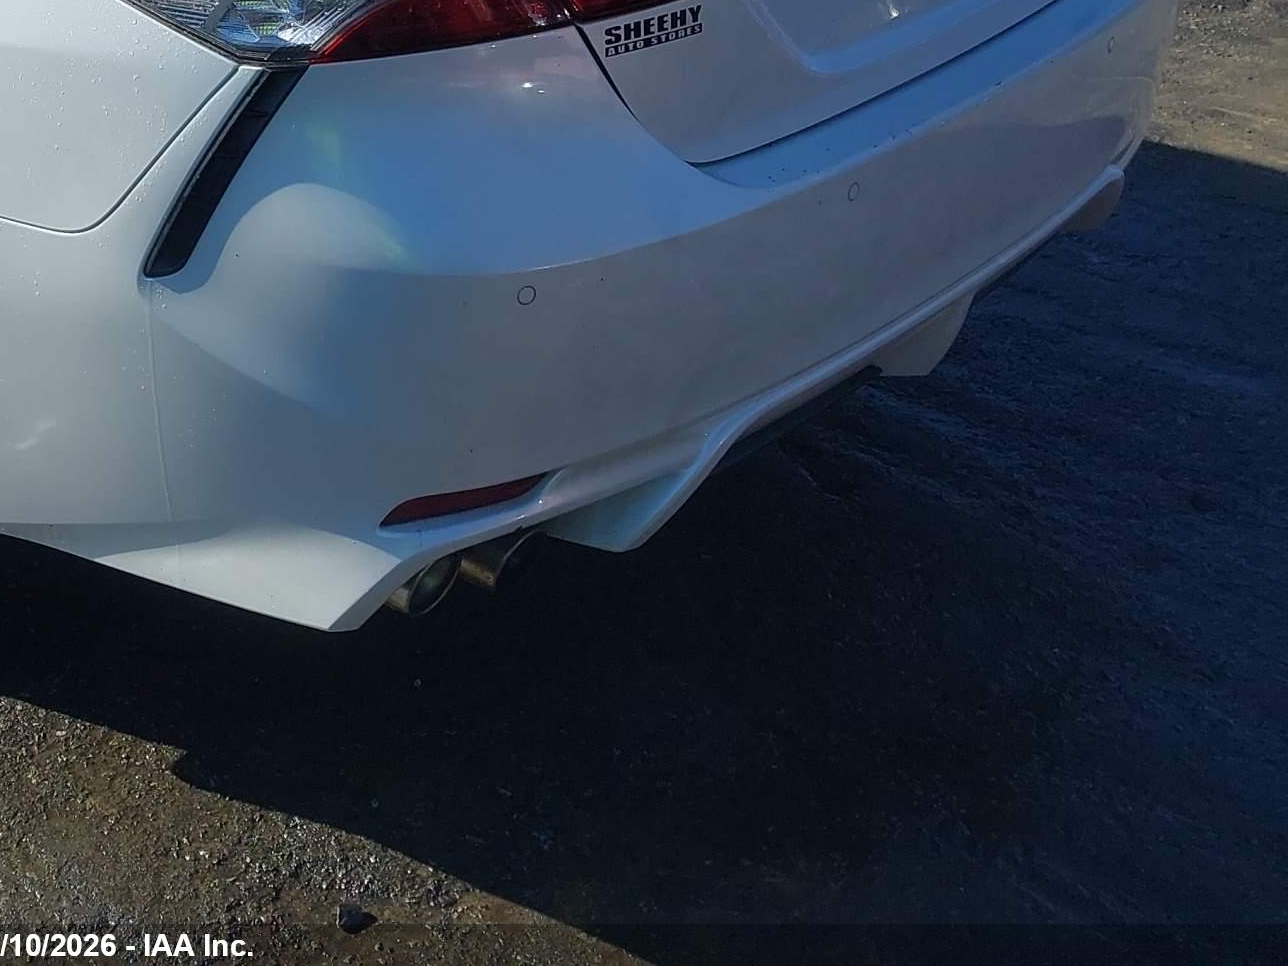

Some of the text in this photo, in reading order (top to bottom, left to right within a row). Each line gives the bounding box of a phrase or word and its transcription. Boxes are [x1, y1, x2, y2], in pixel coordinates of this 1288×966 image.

[604, 4, 702, 46] SHEEHY
[607, 24, 702, 56] AUTO STORES
